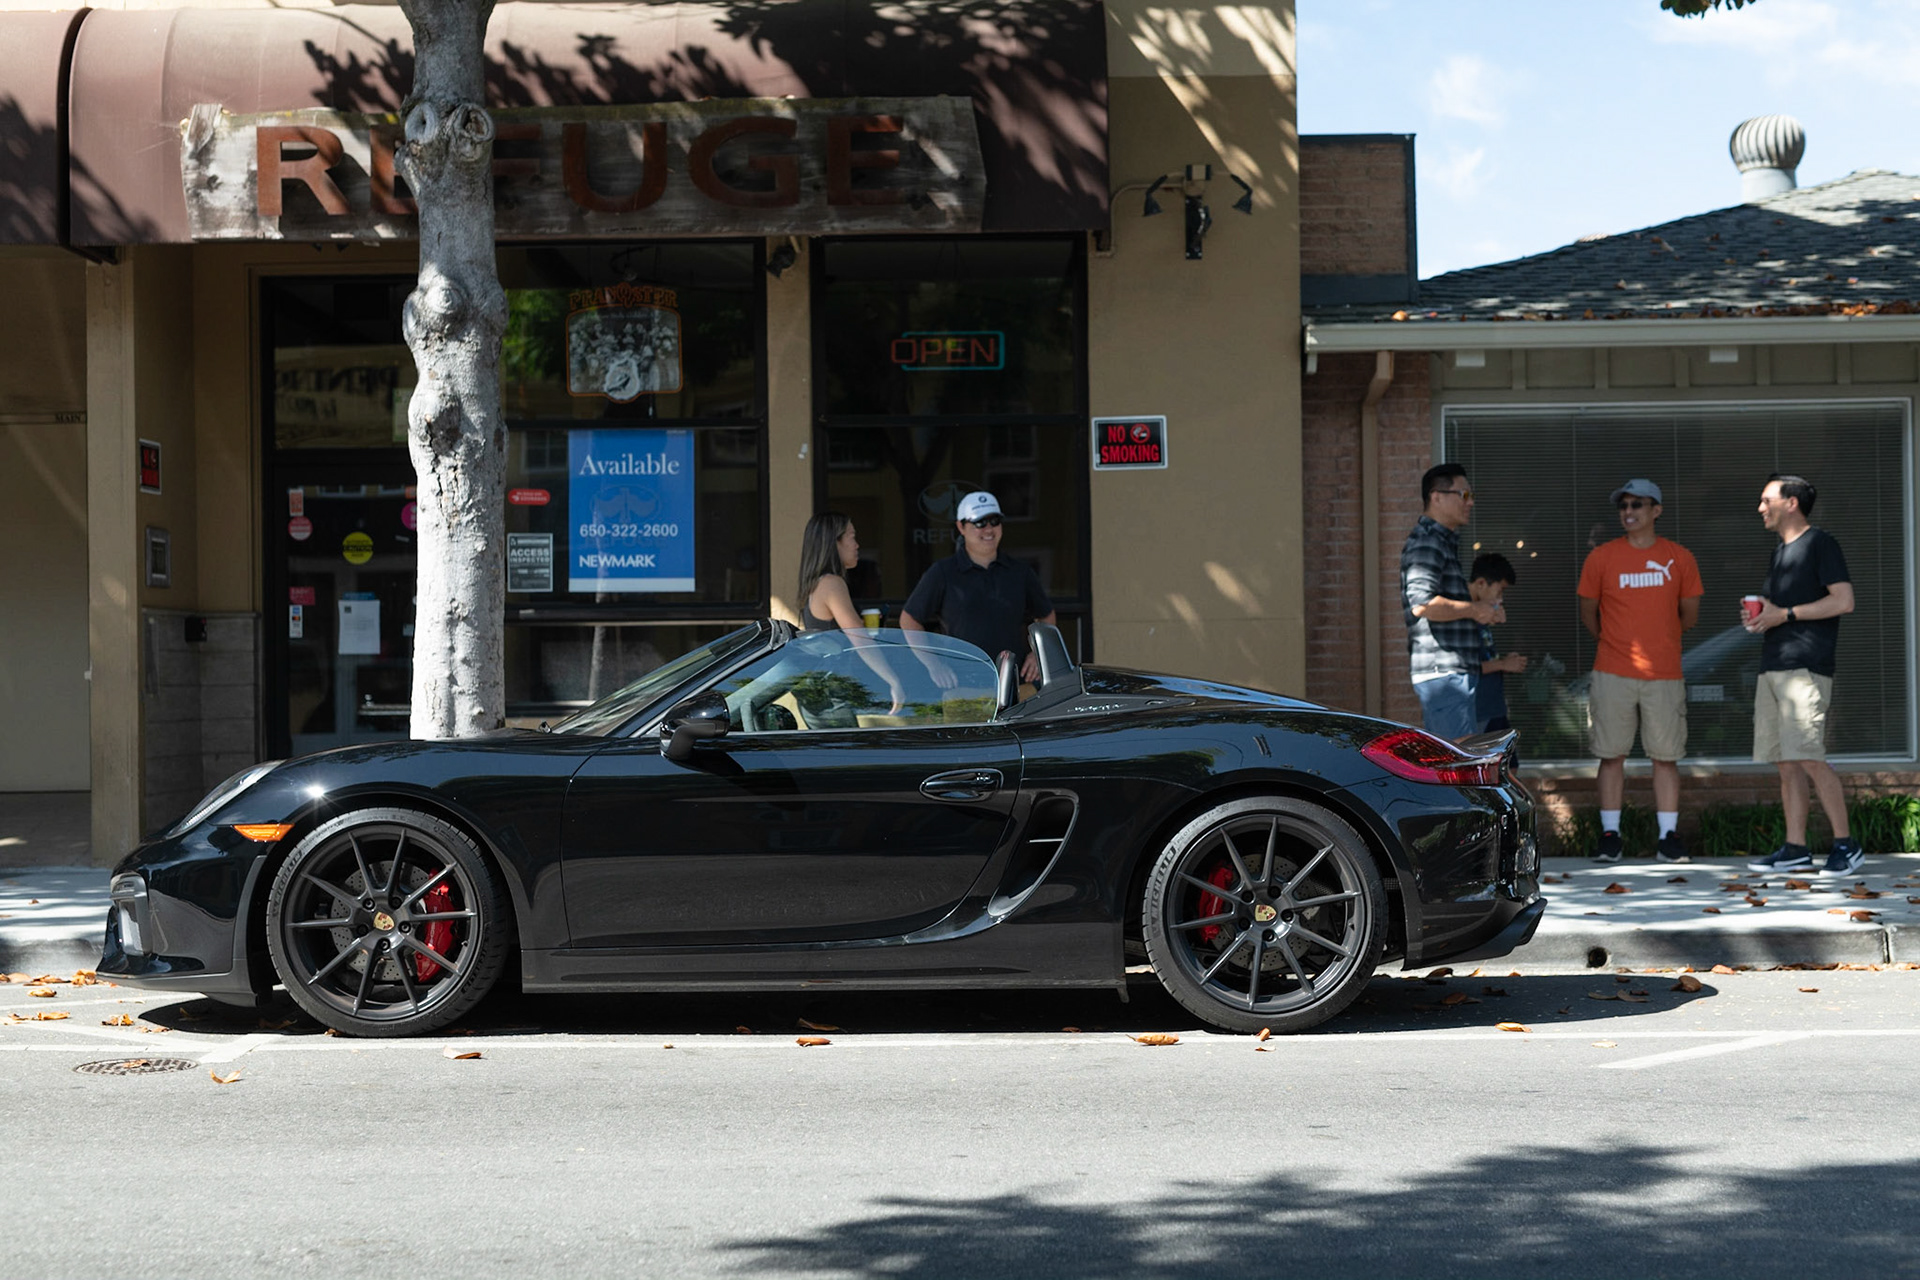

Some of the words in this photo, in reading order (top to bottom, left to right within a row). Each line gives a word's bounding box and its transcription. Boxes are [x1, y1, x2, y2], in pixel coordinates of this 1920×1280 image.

[891, 338, 996, 364] OPEN
[1108, 425, 1126, 443] NO
[1101, 444, 1160, 463] SMOKING
[579, 452, 681, 476] Available
[579, 523, 679, 538] 650-322-2600
[510, 548, 550, 557] ACCESS
[578, 554, 657, 568] NEWMARK
[1619, 572, 1664, 589] PUMA
[1151, 846, 1177, 919] MICHELIN
